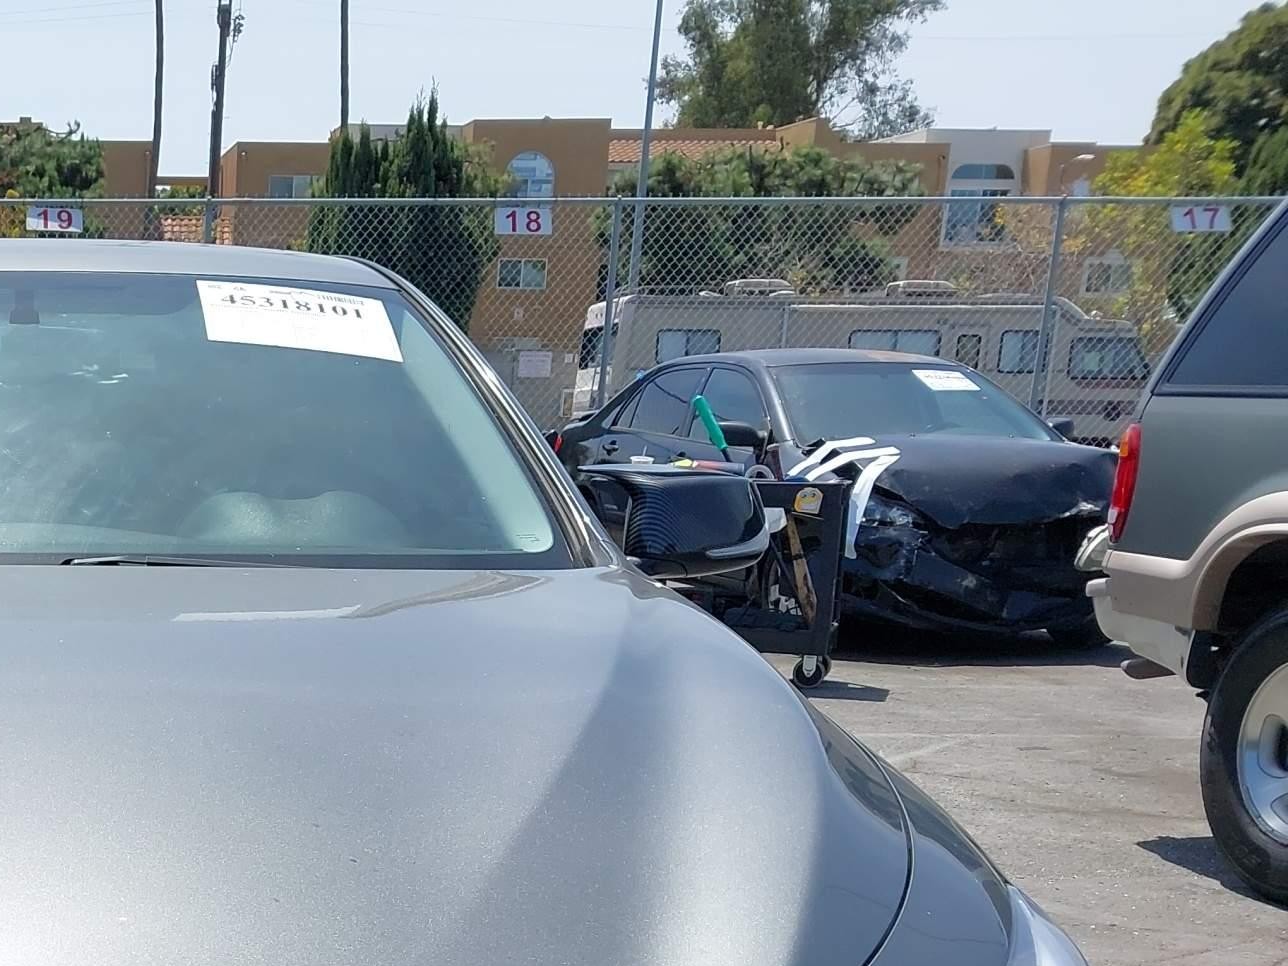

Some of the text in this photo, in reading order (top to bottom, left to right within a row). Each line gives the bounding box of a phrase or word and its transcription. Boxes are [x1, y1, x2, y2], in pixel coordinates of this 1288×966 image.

[37, 208, 73, 229] 19
[505, 210, 541, 232] 18
[1183, 207, 1220, 229] 17
[220, 294, 363, 319] 45318101
